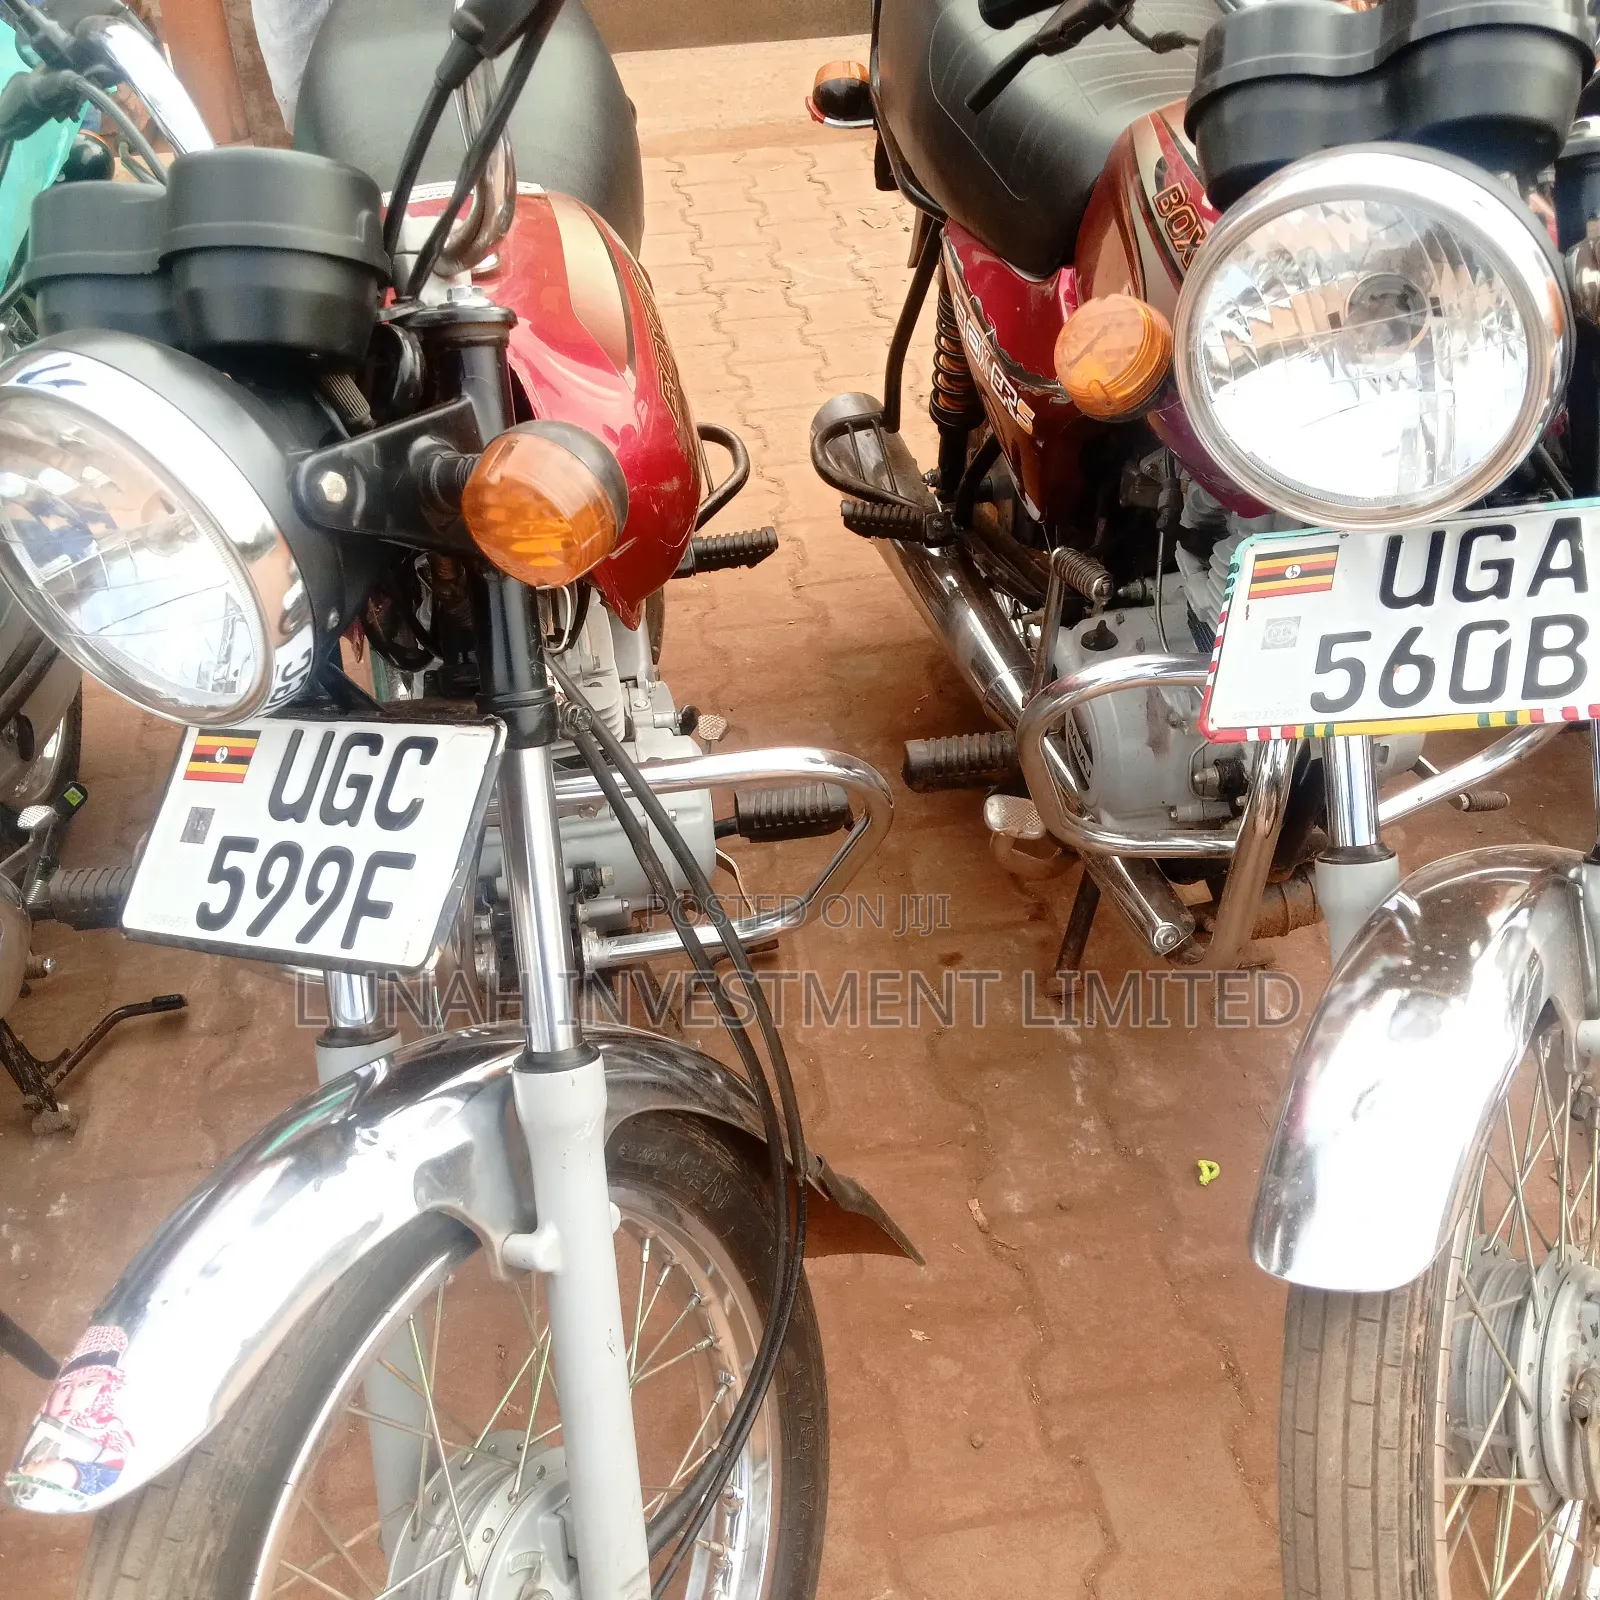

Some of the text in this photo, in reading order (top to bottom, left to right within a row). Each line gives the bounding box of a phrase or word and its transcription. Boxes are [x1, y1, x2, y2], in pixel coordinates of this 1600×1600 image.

[1379, 516, 1589, 609] UGA
[1310, 613, 1590, 713] 560B
[268, 729, 439, 831] UGC
[195, 835, 416, 950] 599F
